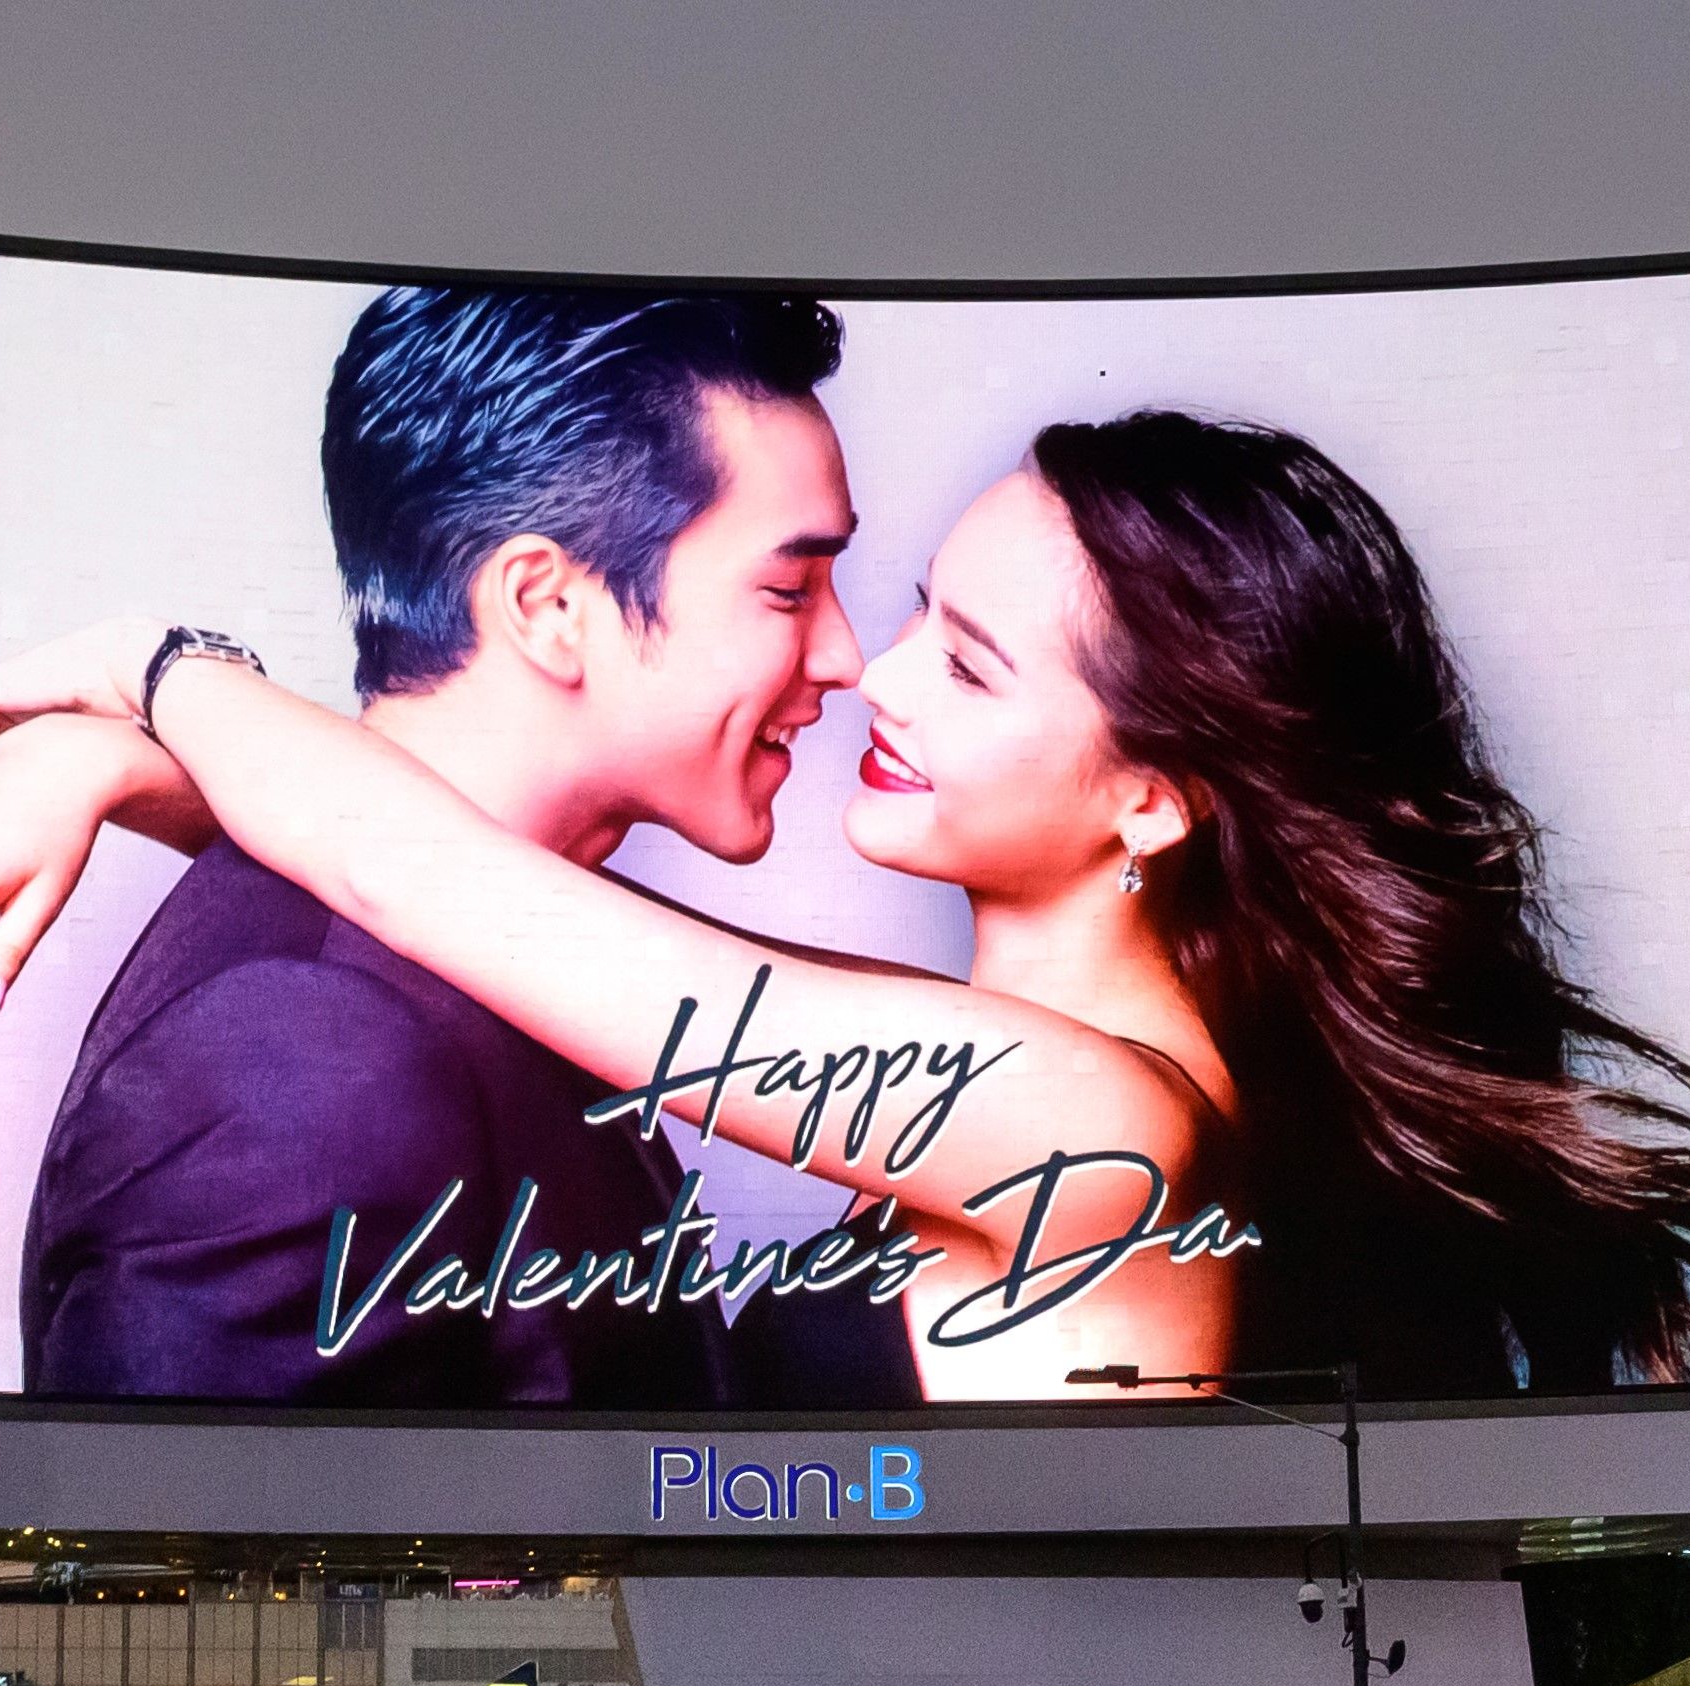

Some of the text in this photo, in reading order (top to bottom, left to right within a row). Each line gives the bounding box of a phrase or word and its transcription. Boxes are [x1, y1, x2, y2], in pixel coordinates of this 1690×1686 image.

[584, 963, 1023, 1181] Happy
[317, 1150, 1262, 1357] Valentine's Da
